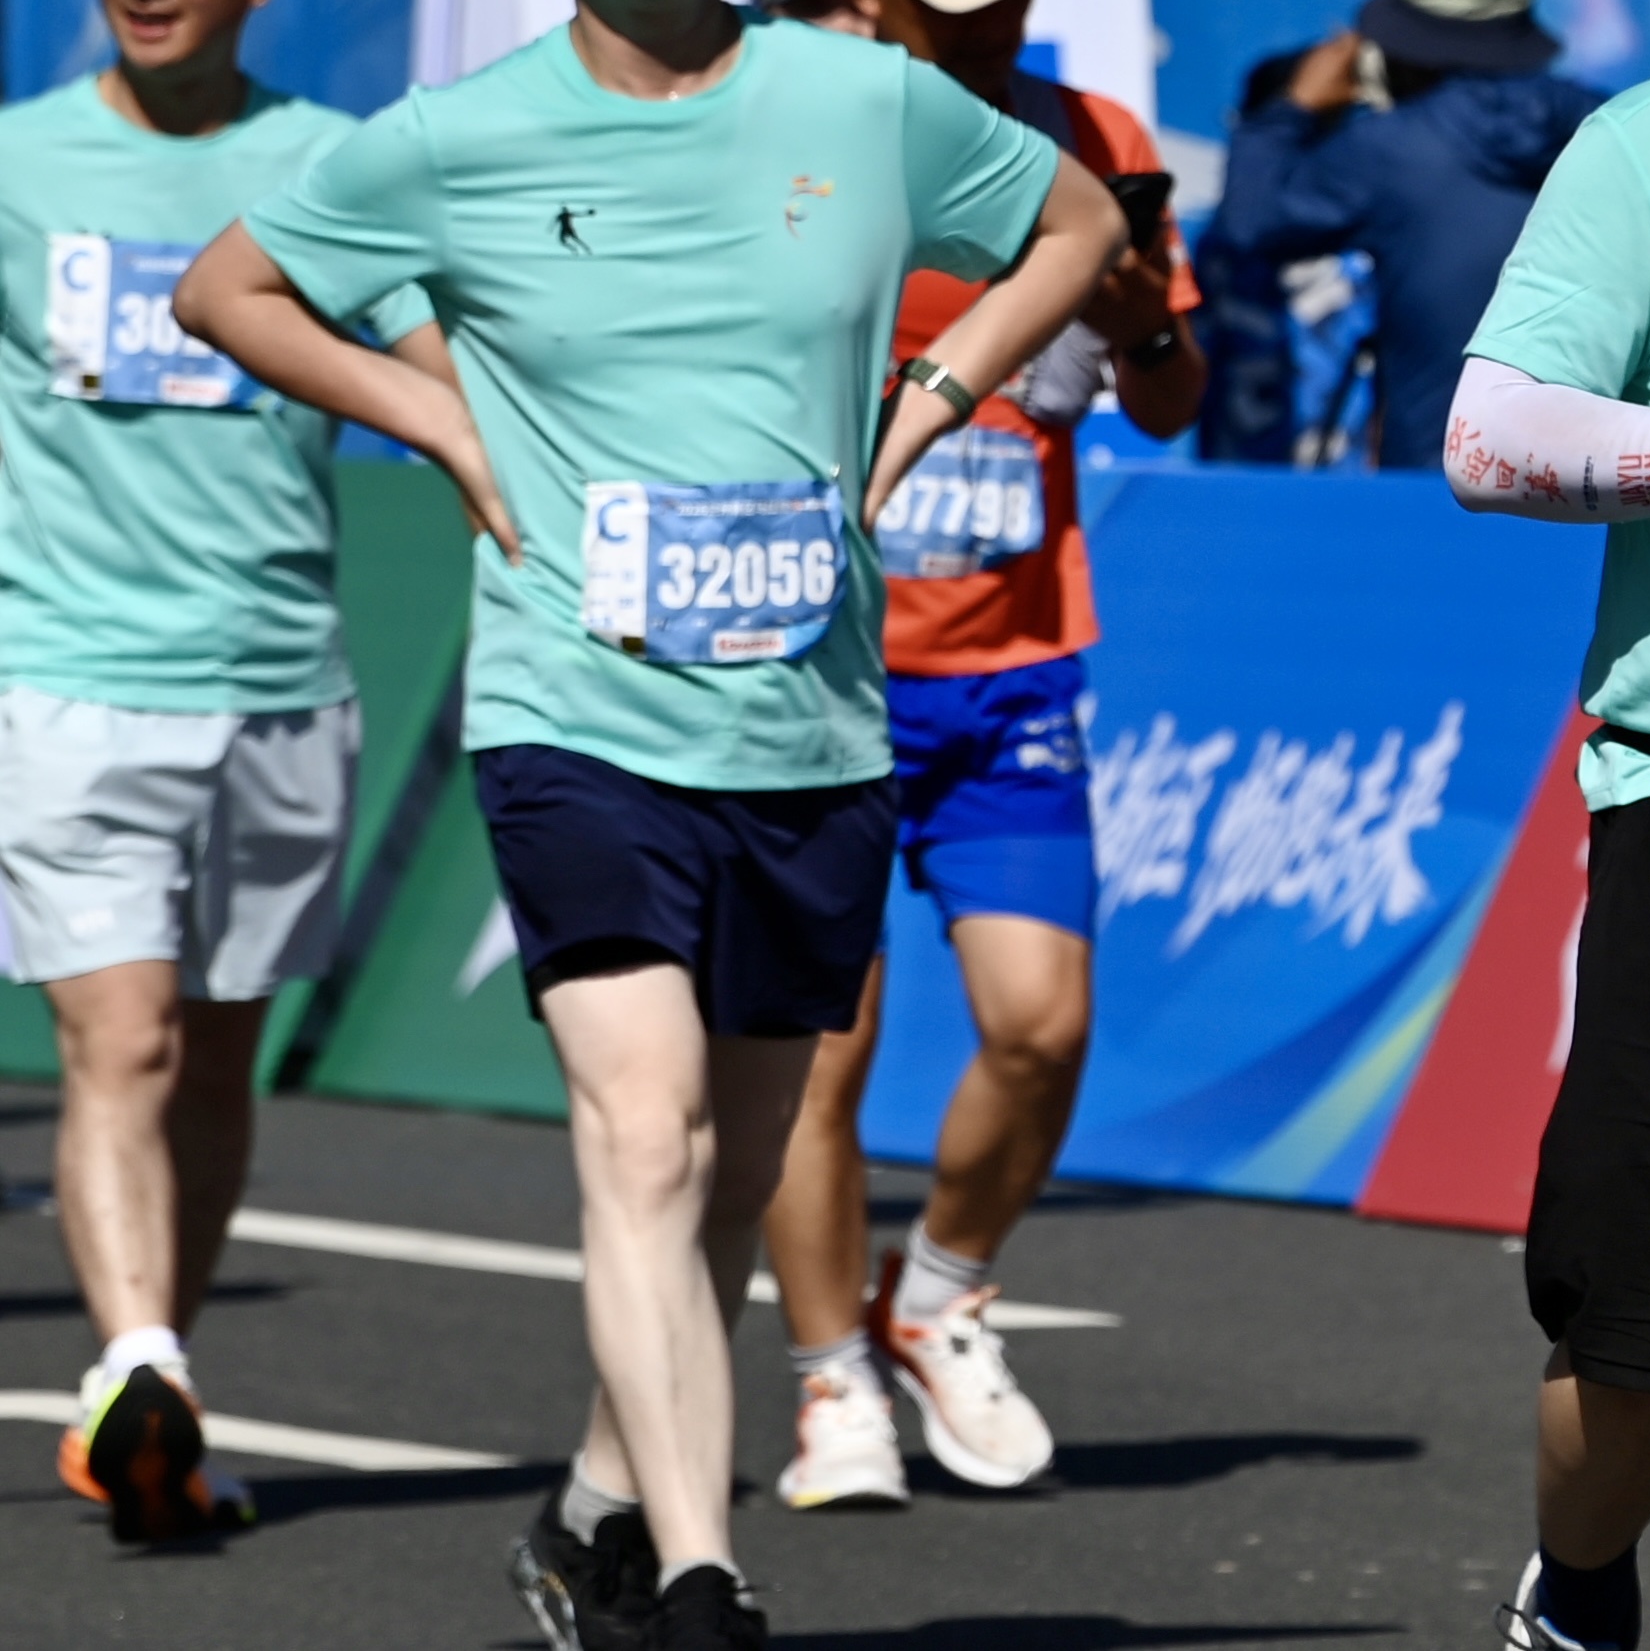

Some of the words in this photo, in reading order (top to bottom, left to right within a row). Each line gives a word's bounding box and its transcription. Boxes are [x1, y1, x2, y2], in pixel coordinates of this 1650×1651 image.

[62, 250, 95, 292] C
[1617, 454, 1650, 507] JIAYU
[597, 499, 629, 542] C
[657, 540, 836, 611] 32056
